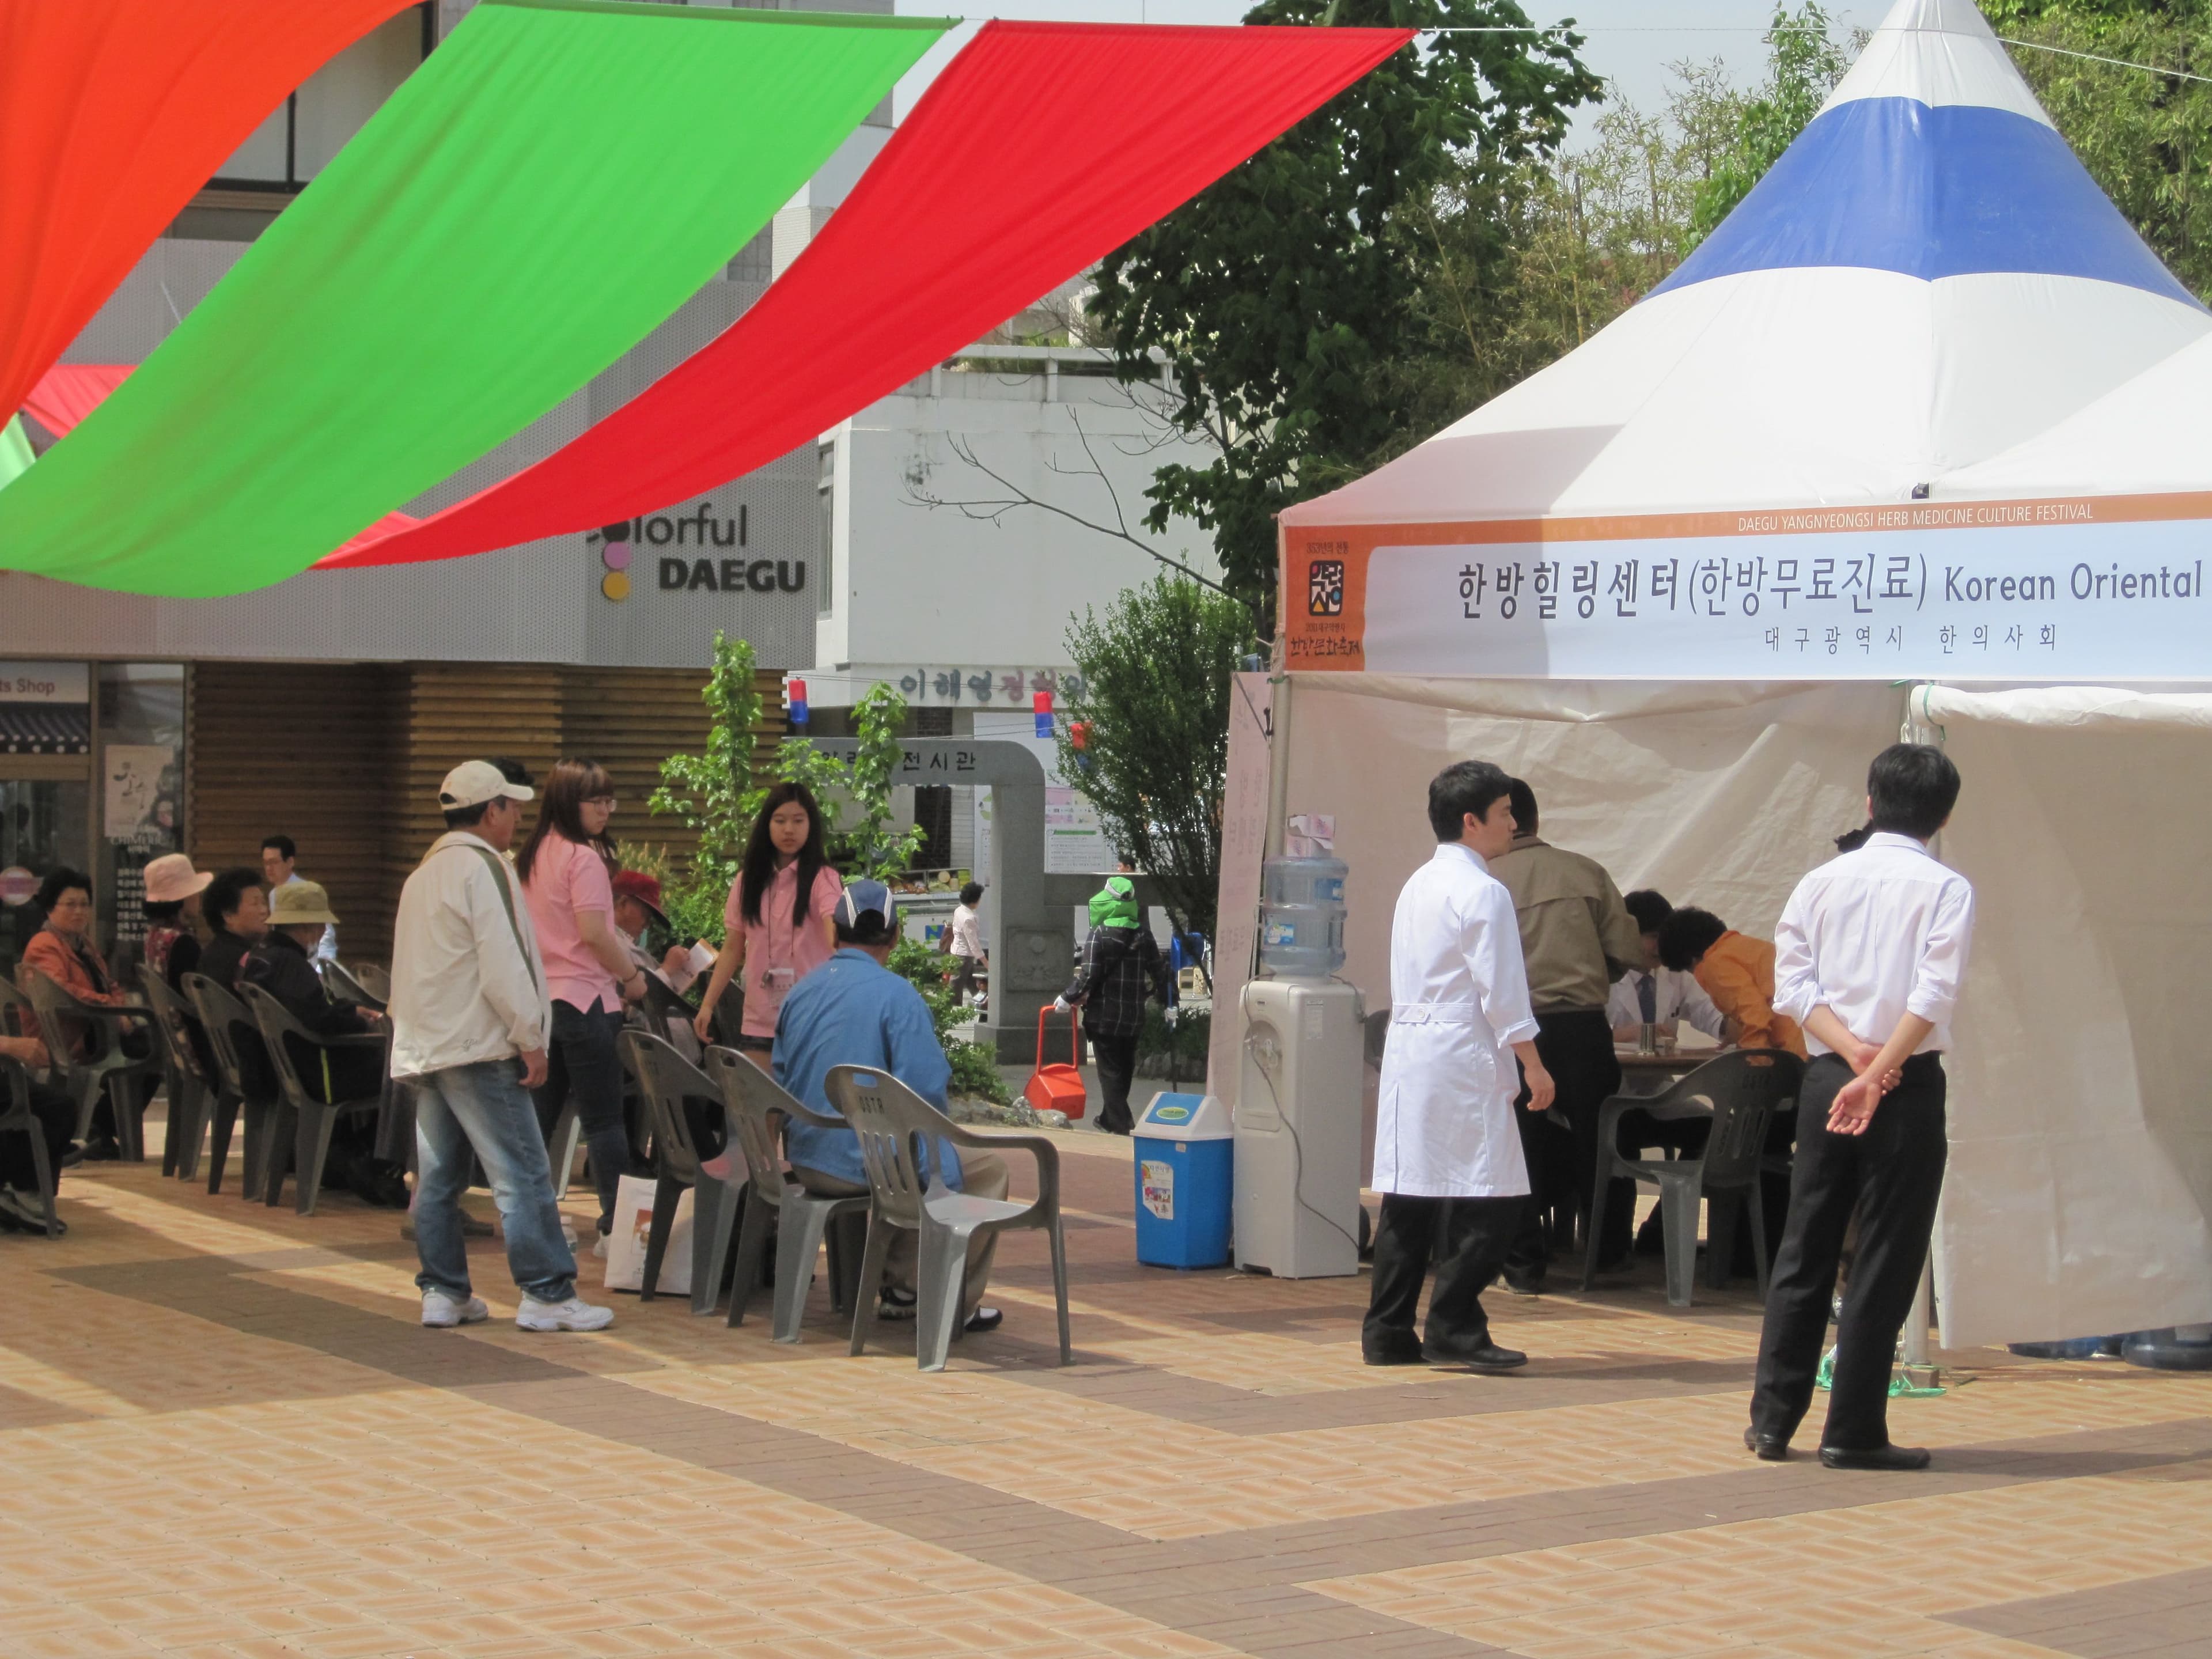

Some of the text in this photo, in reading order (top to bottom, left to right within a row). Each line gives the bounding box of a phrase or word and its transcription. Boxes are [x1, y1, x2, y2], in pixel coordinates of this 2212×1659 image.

[1738, 503, 2093, 532] DAEGU YANGNYEONGSI HERB MEDICINE CULTURE FESTIVAL
[659, 557, 806, 593] DAEGU
[1945, 559, 2202, 601] Korean Oriental
[1290, 635, 1361, 657] 한방문화축제
[1764, 623, 2056, 655] 대구광역시 한의사회
[16, 677, 56, 697] Shop
